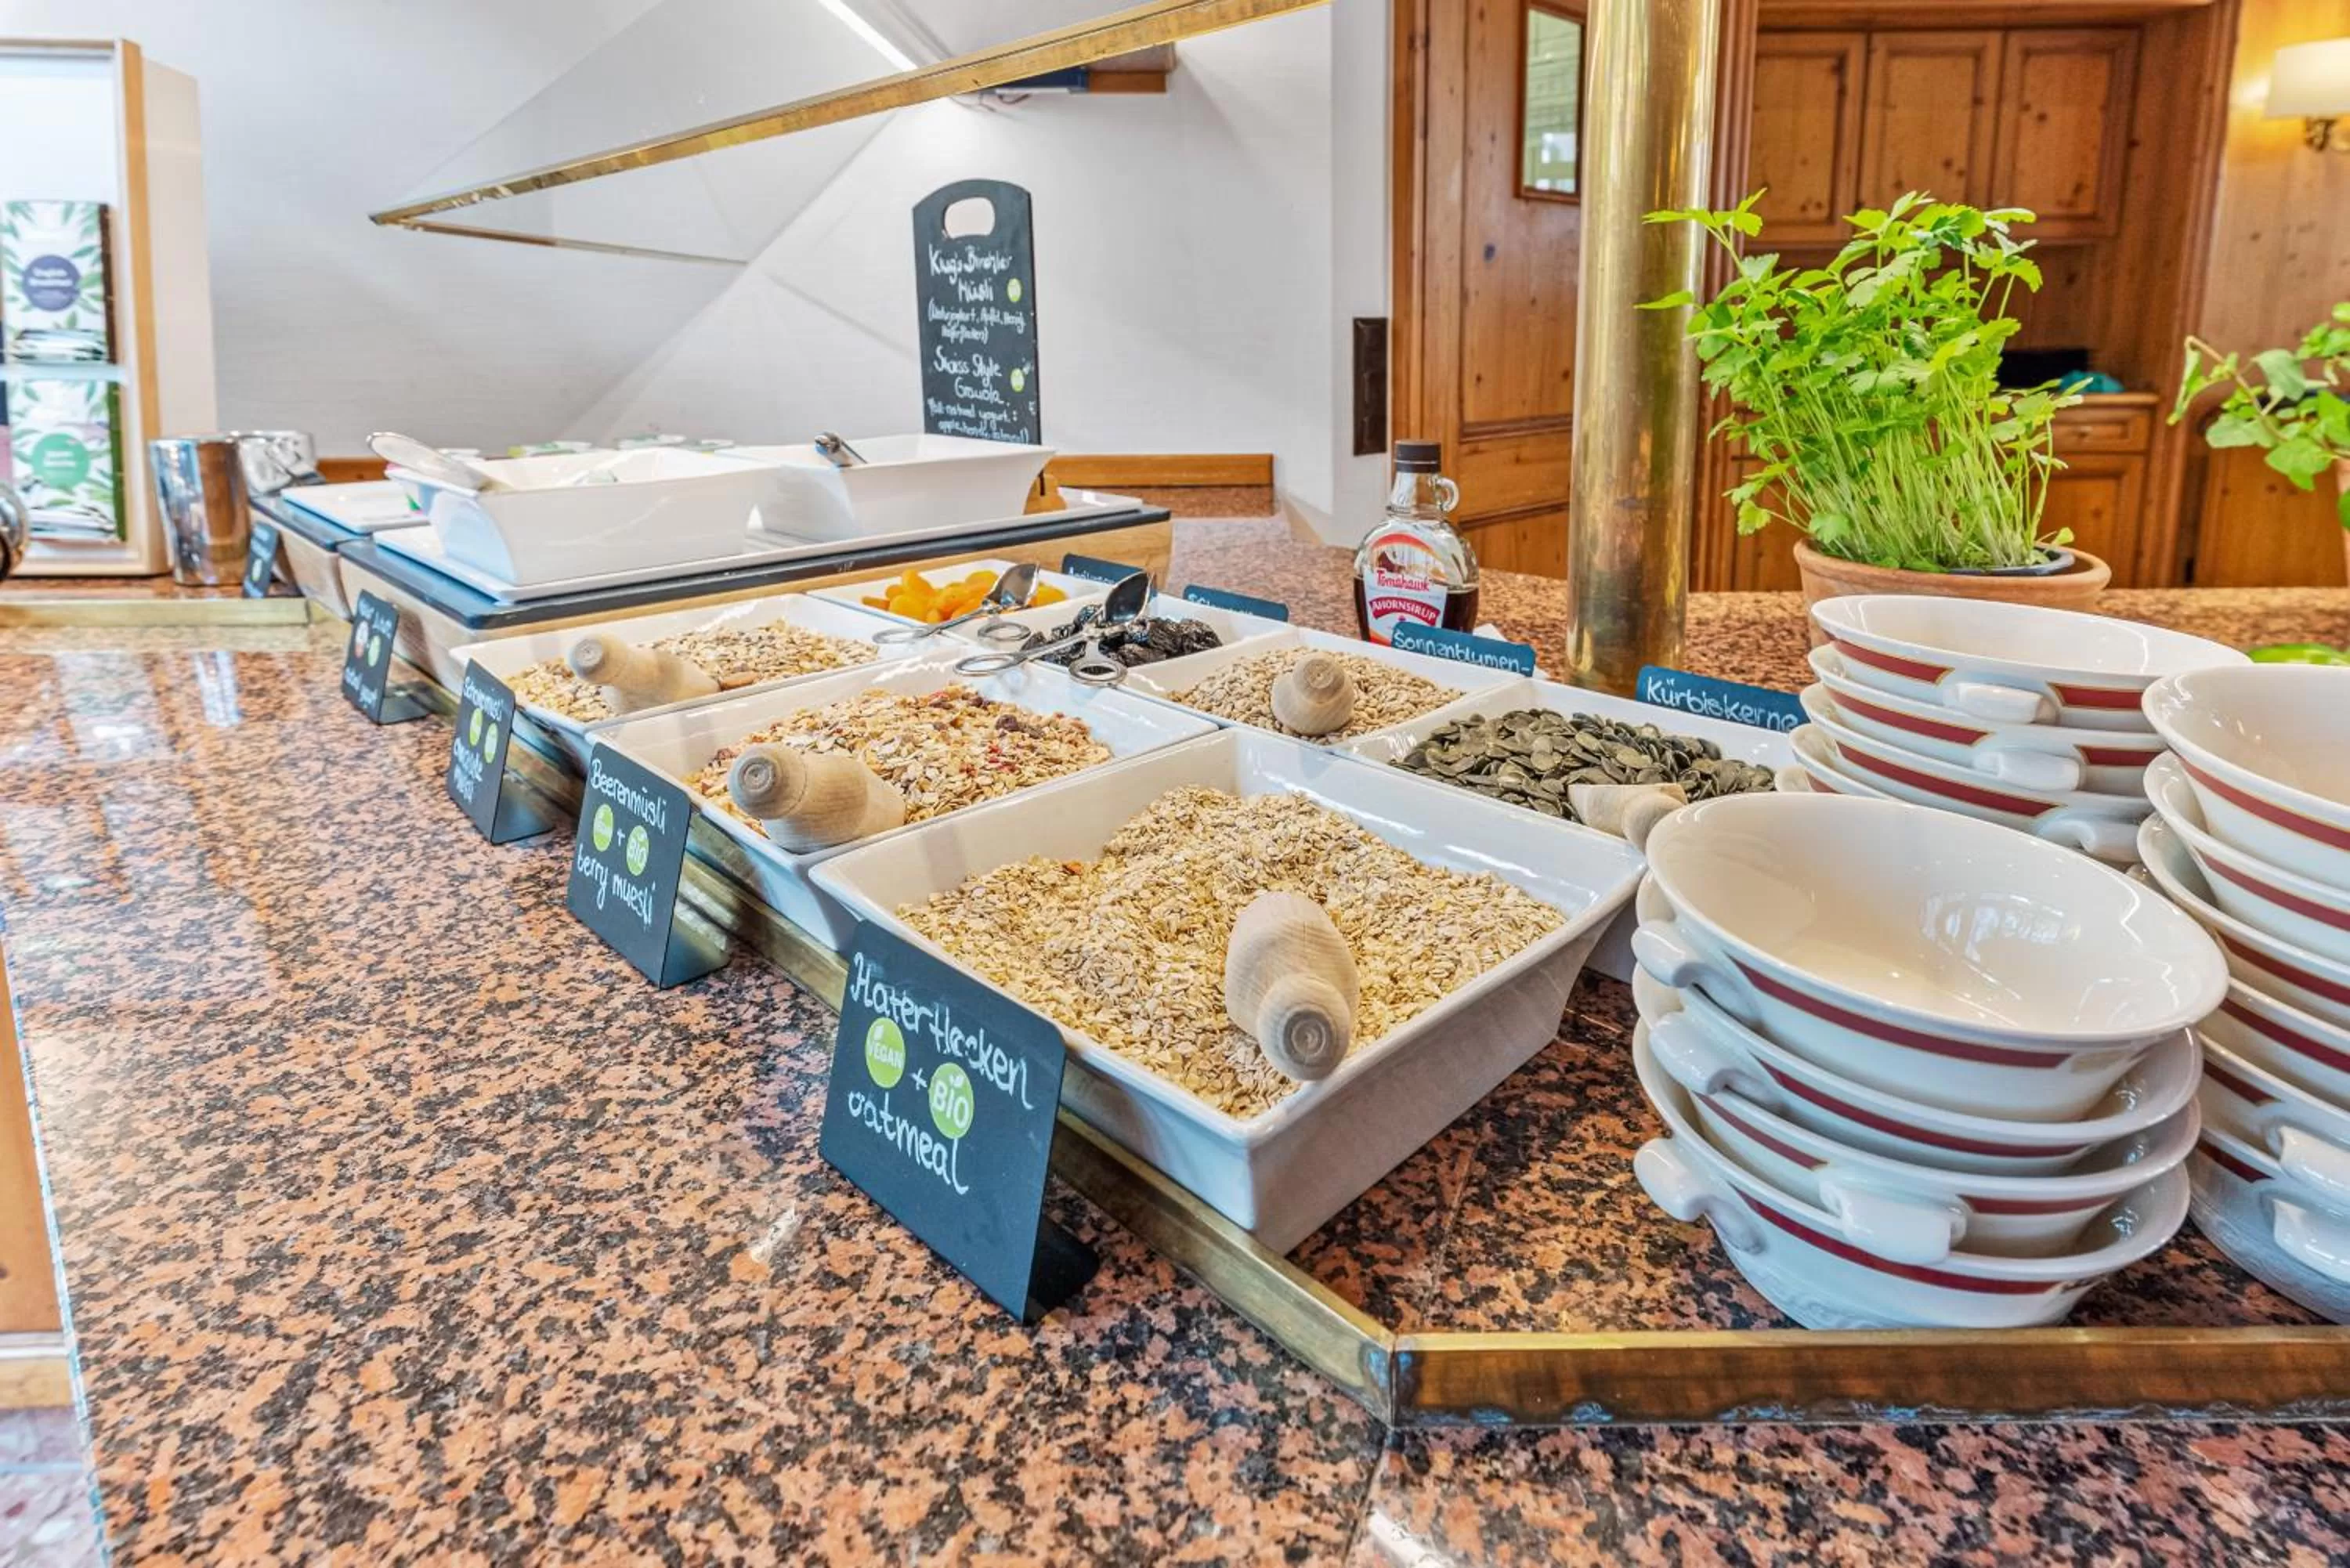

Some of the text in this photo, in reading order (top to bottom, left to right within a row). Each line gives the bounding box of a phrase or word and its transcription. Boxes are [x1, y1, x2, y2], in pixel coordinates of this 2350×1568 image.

[958, 277, 993, 302] Müsli
[933, 345, 970, 375] Swiss
[972, 354, 1003, 387] Style
[1372, 600, 1437, 620] AHORNSIRUP
[1647, 676, 1799, 732] Kürbiskerne
[590, 757, 667, 835] Beerenmüsli
[612, 880, 657, 927] muesli
[867, 1039, 905, 1069] VEGAN
[933, 1075, 970, 1129] BIO
[848, 1090, 970, 1196] oatmeal
